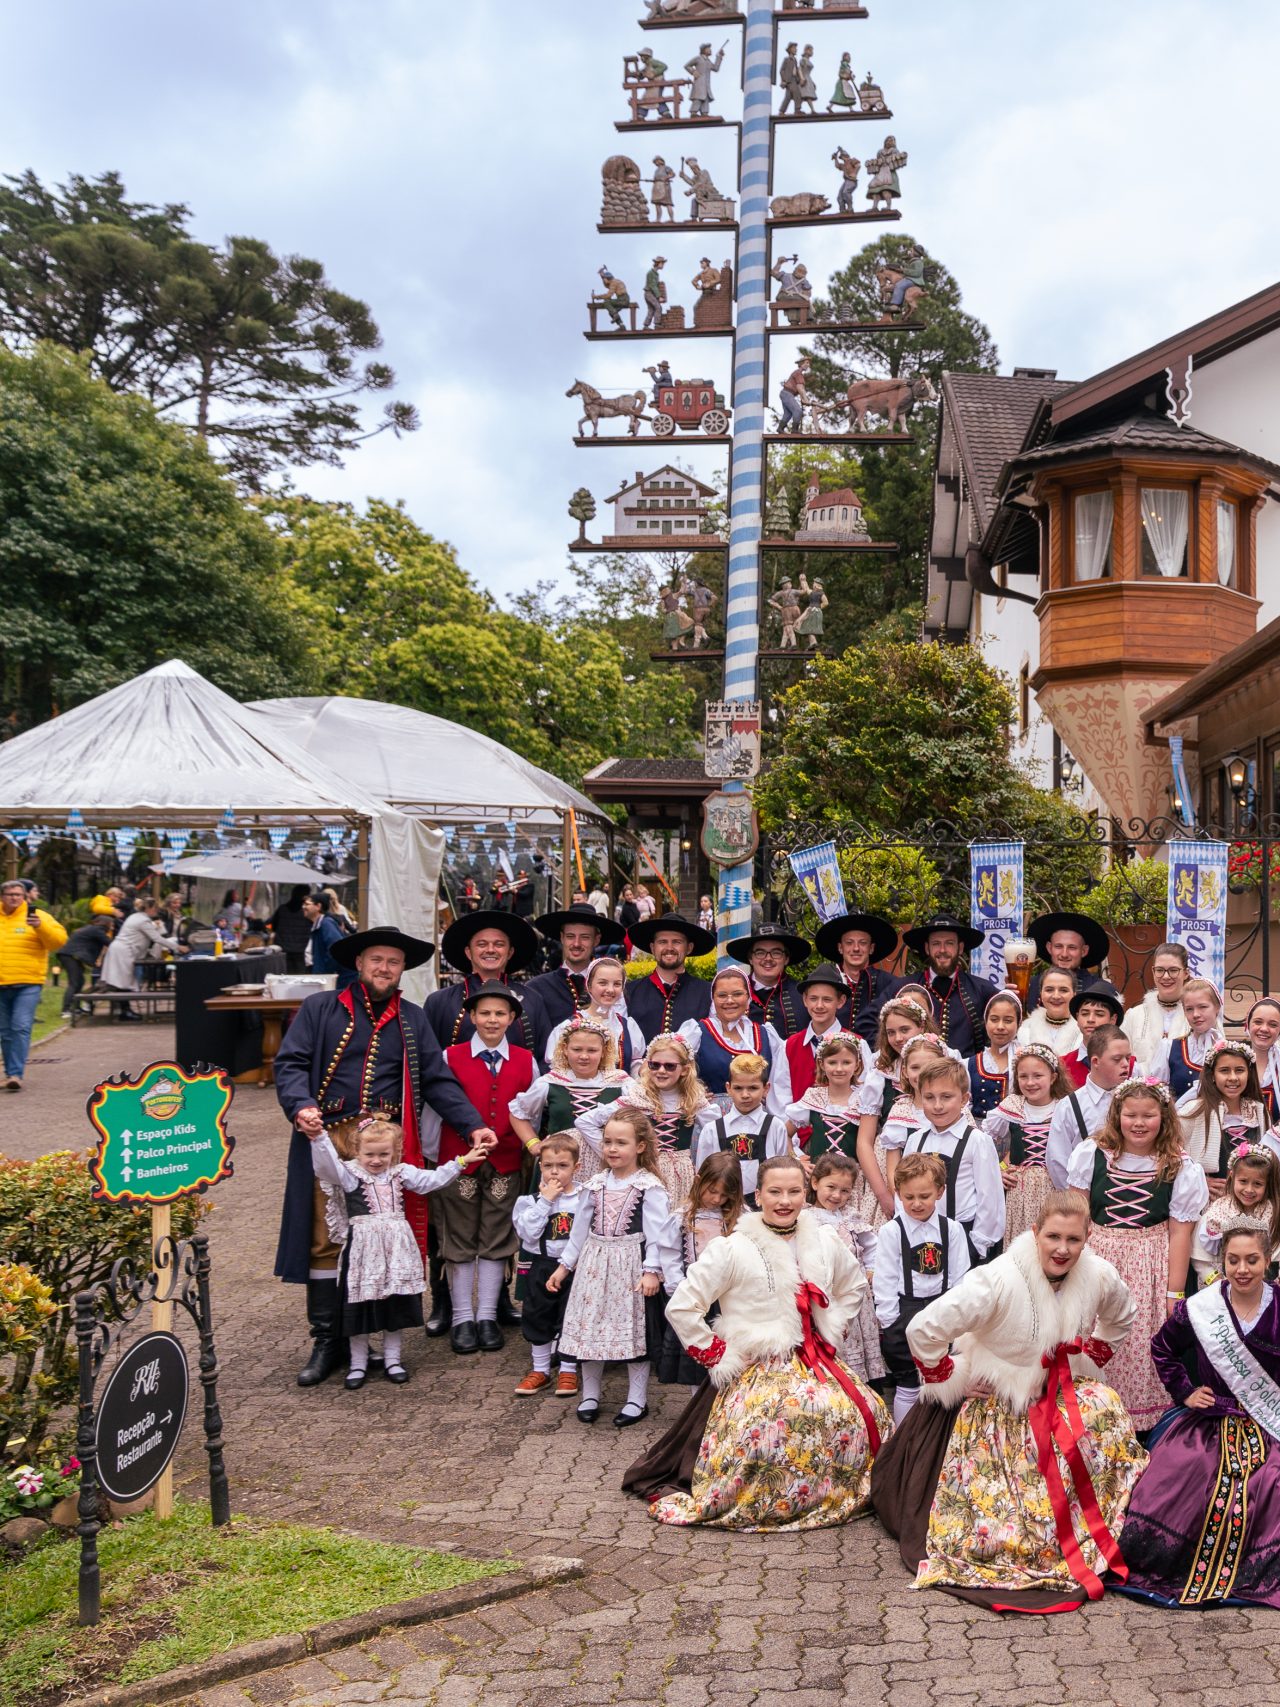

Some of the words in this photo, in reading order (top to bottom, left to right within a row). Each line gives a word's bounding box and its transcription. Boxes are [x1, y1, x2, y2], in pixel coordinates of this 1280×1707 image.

[983, 918, 1012, 930] PROST
[1180, 920, 1212, 931] PROST
[136, 1129, 172, 1142] Espaço
[174, 1123, 196, 1136] Kids
[136, 1146, 165, 1160] Palco
[166, 1139, 212, 1155] Principal
[136, 1163, 189, 1179] Banheiros
[1210, 1324, 1251, 1379] Princesa
[117, 1411, 156, 1448] Recepção
[116, 1430, 163, 1473] Restaurante
